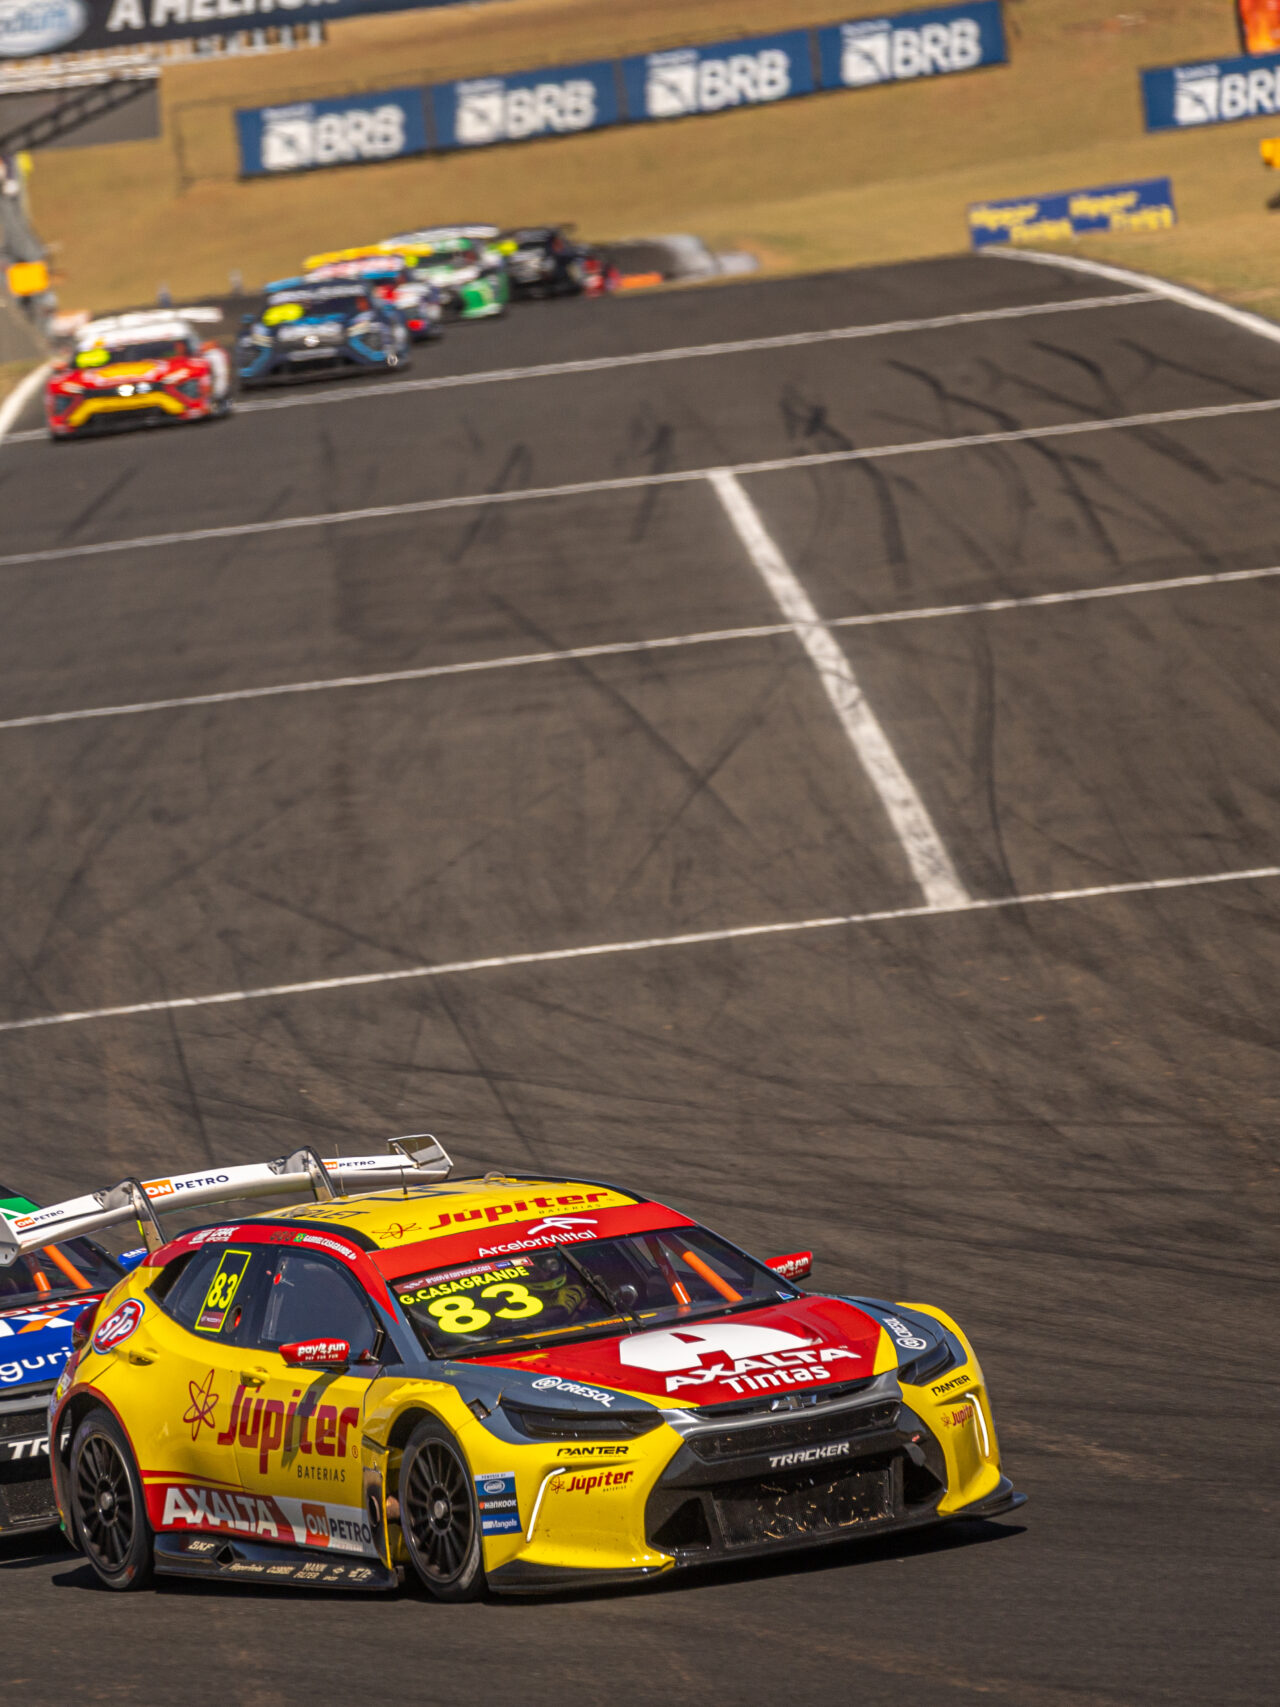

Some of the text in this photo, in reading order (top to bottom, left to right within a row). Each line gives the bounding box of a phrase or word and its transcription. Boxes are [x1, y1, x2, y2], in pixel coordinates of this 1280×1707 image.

[892, 18, 983, 79] BRB
[699, 49, 791, 111] BRB
[1220, 66, 1280, 120] BR
[505, 79, 596, 139] BRB
[338, 1159, 375, 1168] PETRO
[145, 1174, 230, 1197] ON PETRO
[34, 1208, 65, 1223] PETRO
[478, 1228, 598, 1258] ArcelorMittal
[207, 1272, 238, 1309] 83
[399, 1265, 530, 1306] G.CASAGRANDE
[427, 1281, 545, 1334] 83
[95, 1303, 138, 1349] STP
[666, 1346, 861, 1393] AXALTA
[720, 1364, 832, 1395] Tintas
[931, 1374, 971, 1397] PANTER
[556, 1382, 616, 1408] CRESOL
[556, 1445, 629, 1457] PANTER
[769, 1441, 850, 1468] TRACKER
[296, 1464, 346, 1483] BATERIAS
[161, 1487, 280, 1539] AXALTA
[306, 1512, 372, 1544] ON PETRO
